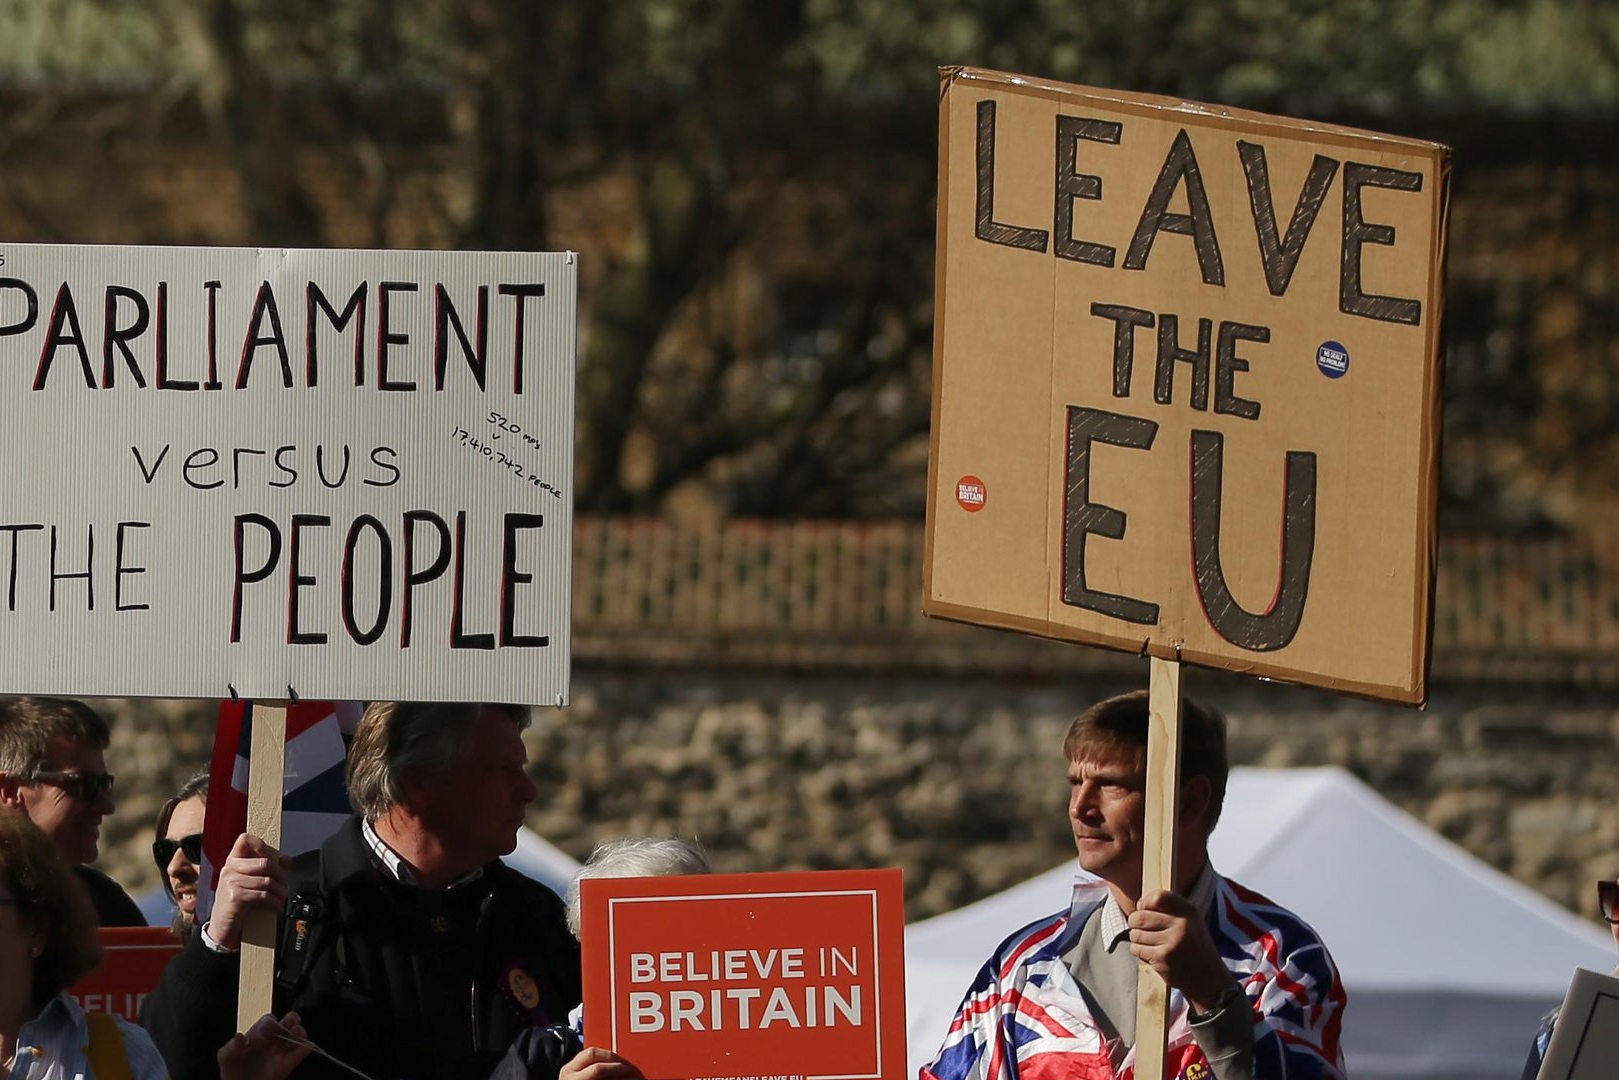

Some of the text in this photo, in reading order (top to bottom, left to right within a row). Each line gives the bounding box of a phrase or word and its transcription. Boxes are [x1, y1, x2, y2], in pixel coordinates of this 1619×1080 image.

[976, 100, 1423, 326] LEAVE
[1090, 302, 1270, 420] THE
[486, 412, 521, 433] 520
[132, 445, 401, 489] versus
[452, 426, 561, 499] 17,410,742 PEOPLE
[1060, 405, 1316, 652] EU
[230, 510, 549, 649] PEOPLE
[630, 946, 857, 983] BELIEVE IN
[629, 984, 862, 1033] BRITAIN
